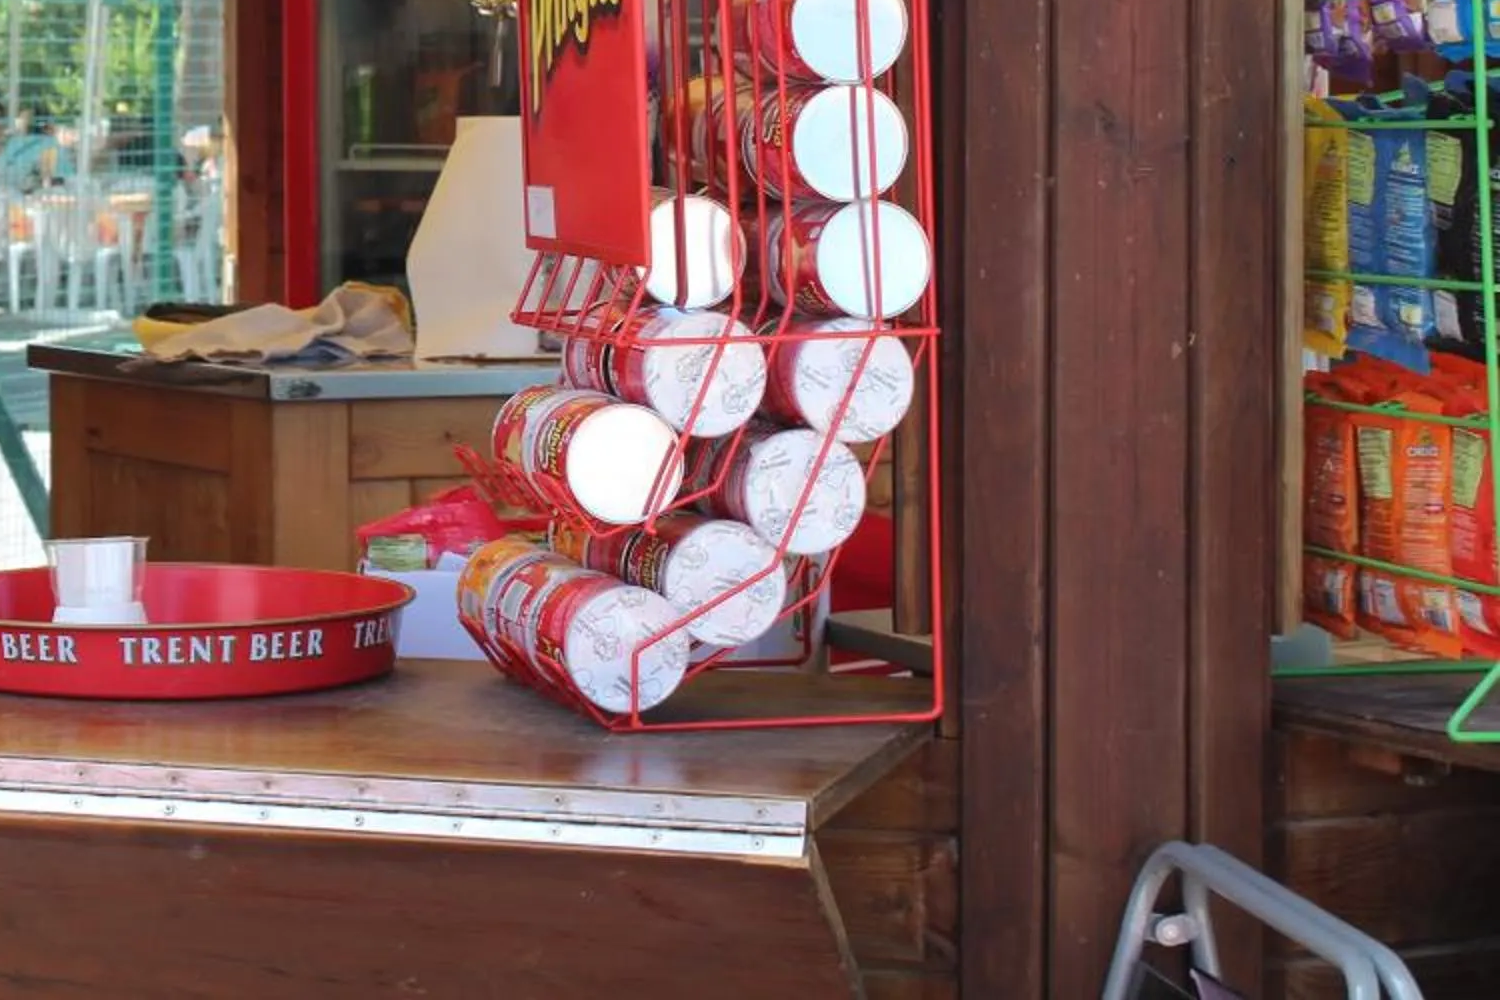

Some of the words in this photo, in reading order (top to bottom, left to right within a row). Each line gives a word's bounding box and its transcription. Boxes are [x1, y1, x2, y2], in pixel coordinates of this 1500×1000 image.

[1, 633, 77, 664] BEER
[119, 635, 237, 665] TRENT
[248, 628, 324, 661] BEER
